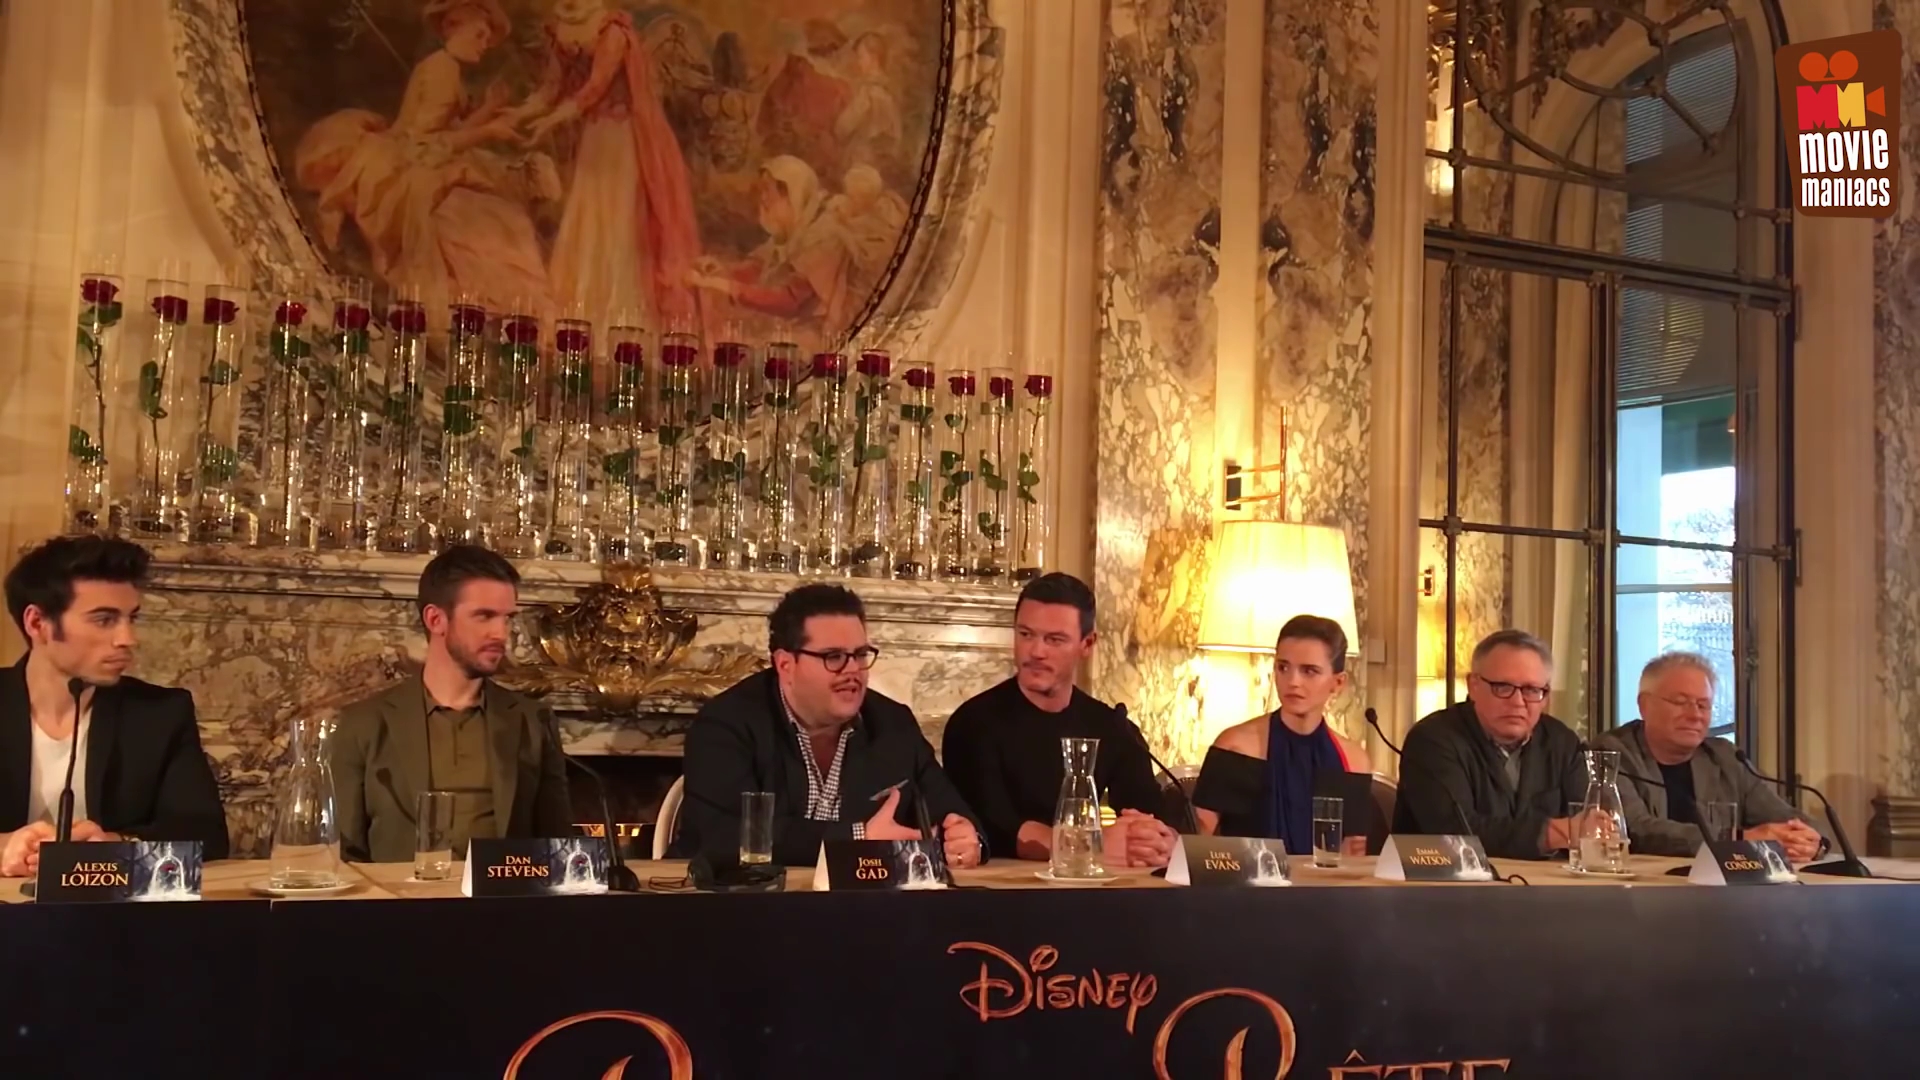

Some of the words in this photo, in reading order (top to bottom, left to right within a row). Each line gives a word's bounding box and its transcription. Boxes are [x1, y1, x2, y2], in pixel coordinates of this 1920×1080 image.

[505, 855, 531, 865] DAN
[1209, 850, 1232, 861] LUKE
[1409, 855, 1452, 866] WATSON
[72, 862, 118, 872] ALEXIS
[858, 857, 882, 868] JOSH
[1205, 860, 1241, 872] EVANS
[1725, 860, 1764, 871] CONDON
[487, 865, 549, 878] STEVENS
[855, 868, 888, 880] GAD
[61, 873, 129, 887] LOIZON
